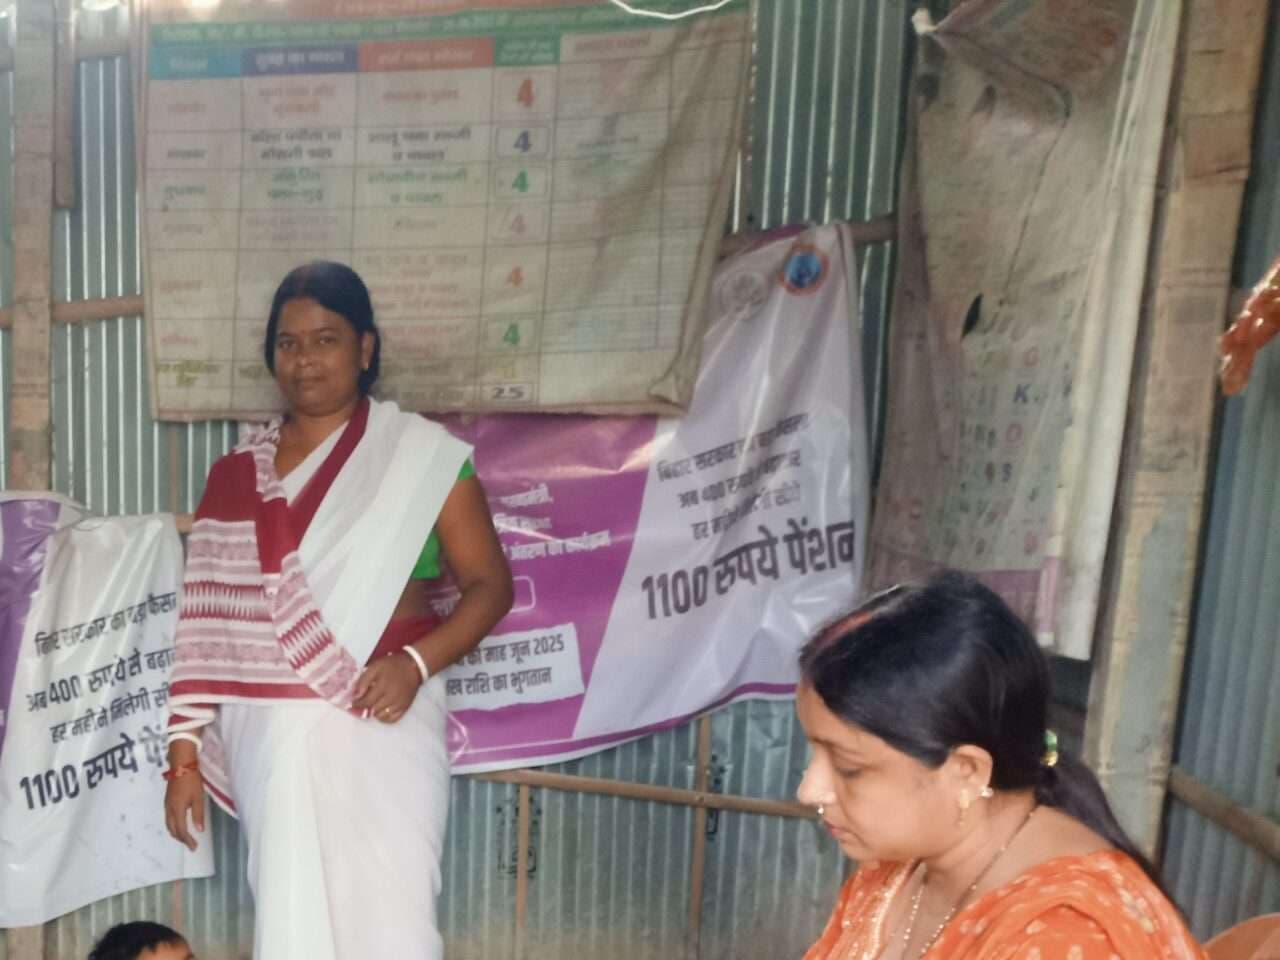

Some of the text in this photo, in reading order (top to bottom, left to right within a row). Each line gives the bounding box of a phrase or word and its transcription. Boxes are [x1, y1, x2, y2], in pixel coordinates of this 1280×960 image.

[517, 79, 535, 107] 4
[513, 130, 531, 153] 4
[511, 171, 530, 193] 4
[503, 323, 520, 345] 4
[493, 384, 526, 399] 25
[641, 515, 856, 620] 1100 रुपये पेंशन
[508, 639, 531, 665] जून
[532, 633, 566, 656] 2025
[48, 674, 82, 705] 400
[127, 648, 142, 678] से
[463, 671, 491, 695] राशि
[492, 673, 508, 692] का
[509, 666, 553, 694] भुगतान
[48, 722, 67, 744] हर
[19, 764, 81, 811] 1100
[81, 731, 139, 790] रुपये
